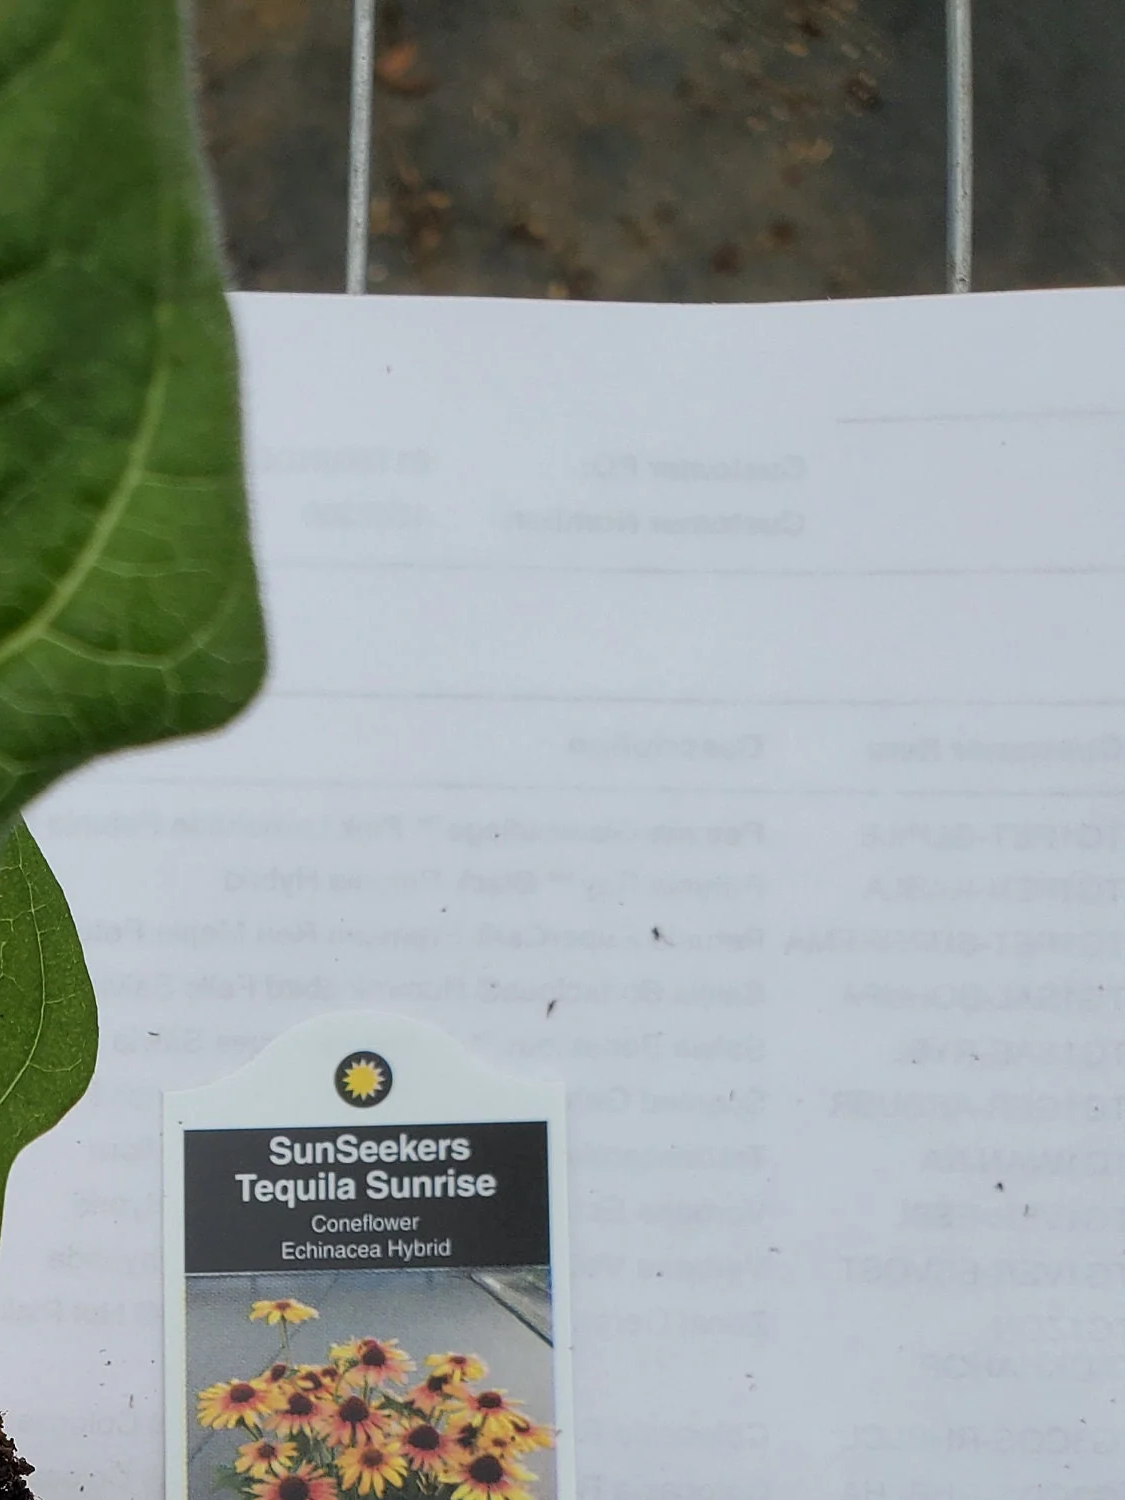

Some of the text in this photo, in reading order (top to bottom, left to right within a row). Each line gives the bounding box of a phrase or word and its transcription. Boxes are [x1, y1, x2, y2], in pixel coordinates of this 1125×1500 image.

[269, 1134, 471, 1166] SunSeekers
[235, 1168, 497, 1208] Tequila Sunrise
[311, 1214, 419, 1233] Coneflower
[281, 1238, 452, 1261] Echinacea Hybrid
